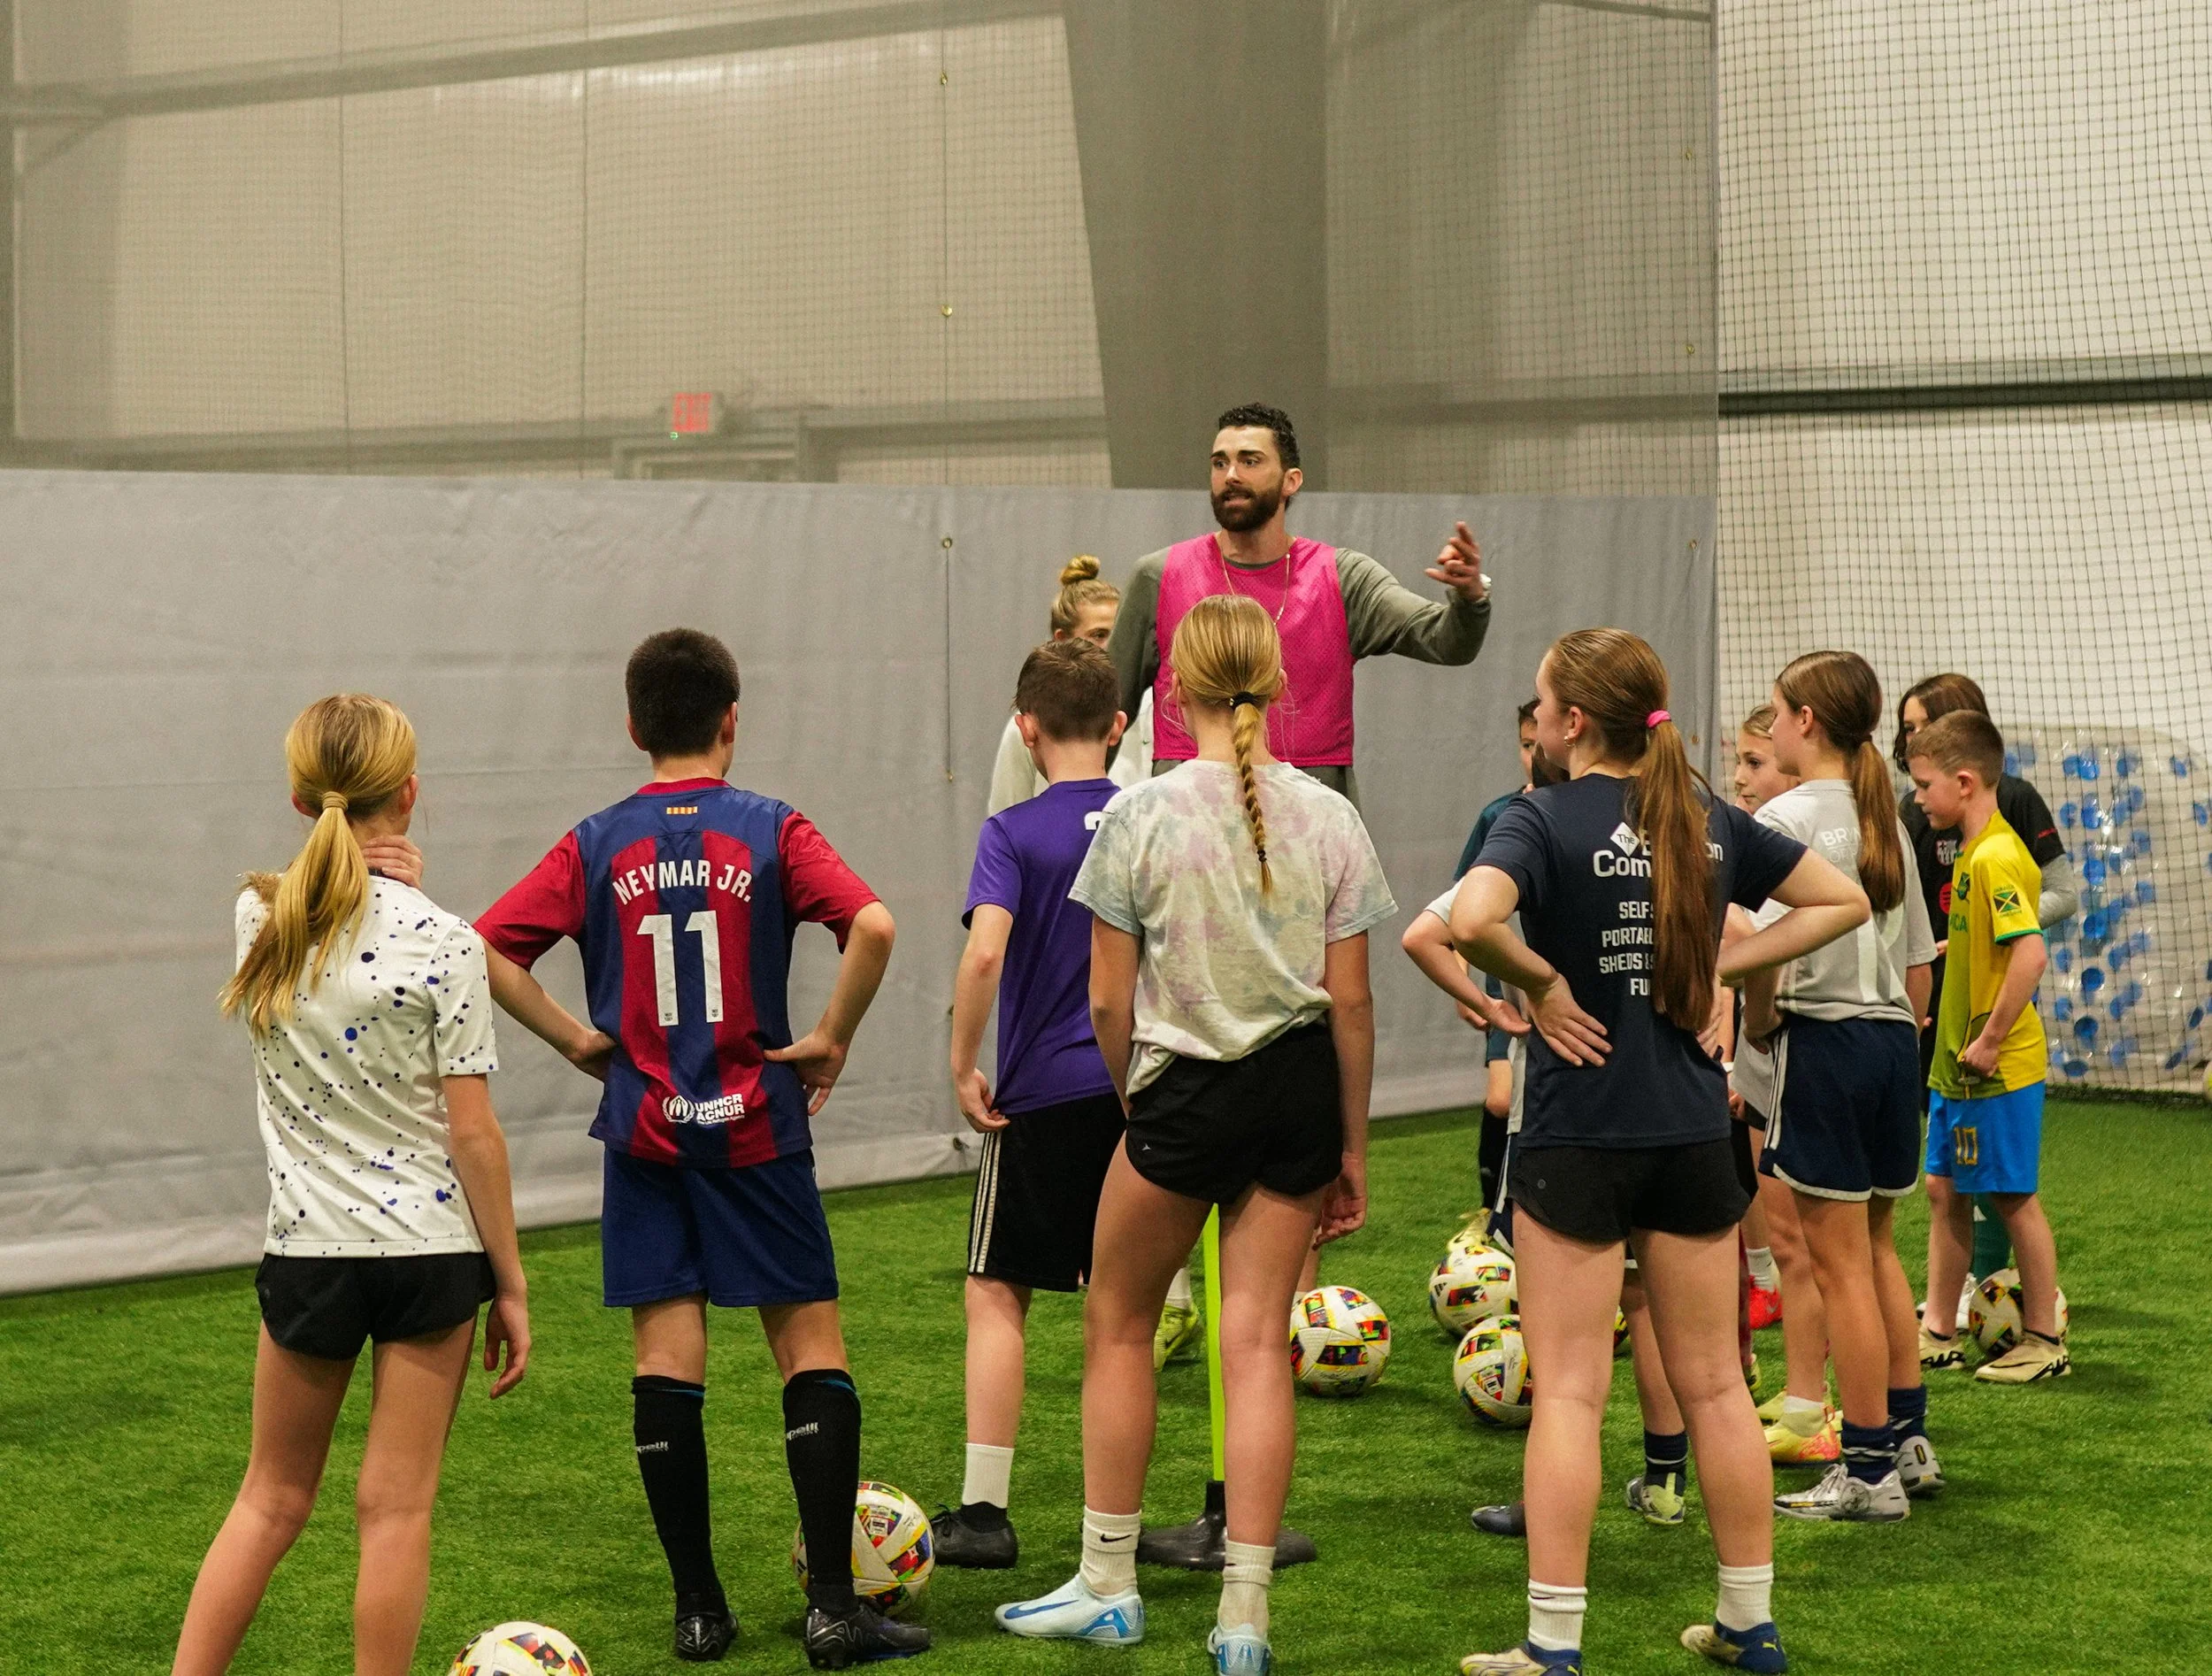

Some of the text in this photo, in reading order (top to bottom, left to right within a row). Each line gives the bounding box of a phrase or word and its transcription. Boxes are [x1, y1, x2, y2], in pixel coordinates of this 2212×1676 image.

[1617, 834, 1635, 845] The
[612, 859, 752, 905] NEYMAR JR.
[637, 910, 724, 1027] 11
[1599, 952, 1643, 973] SHEDS
[695, 1094, 742, 1112] UNHCR
[696, 1103, 745, 1121] ACNUR
[1954, 1126, 1978, 1165] 10
